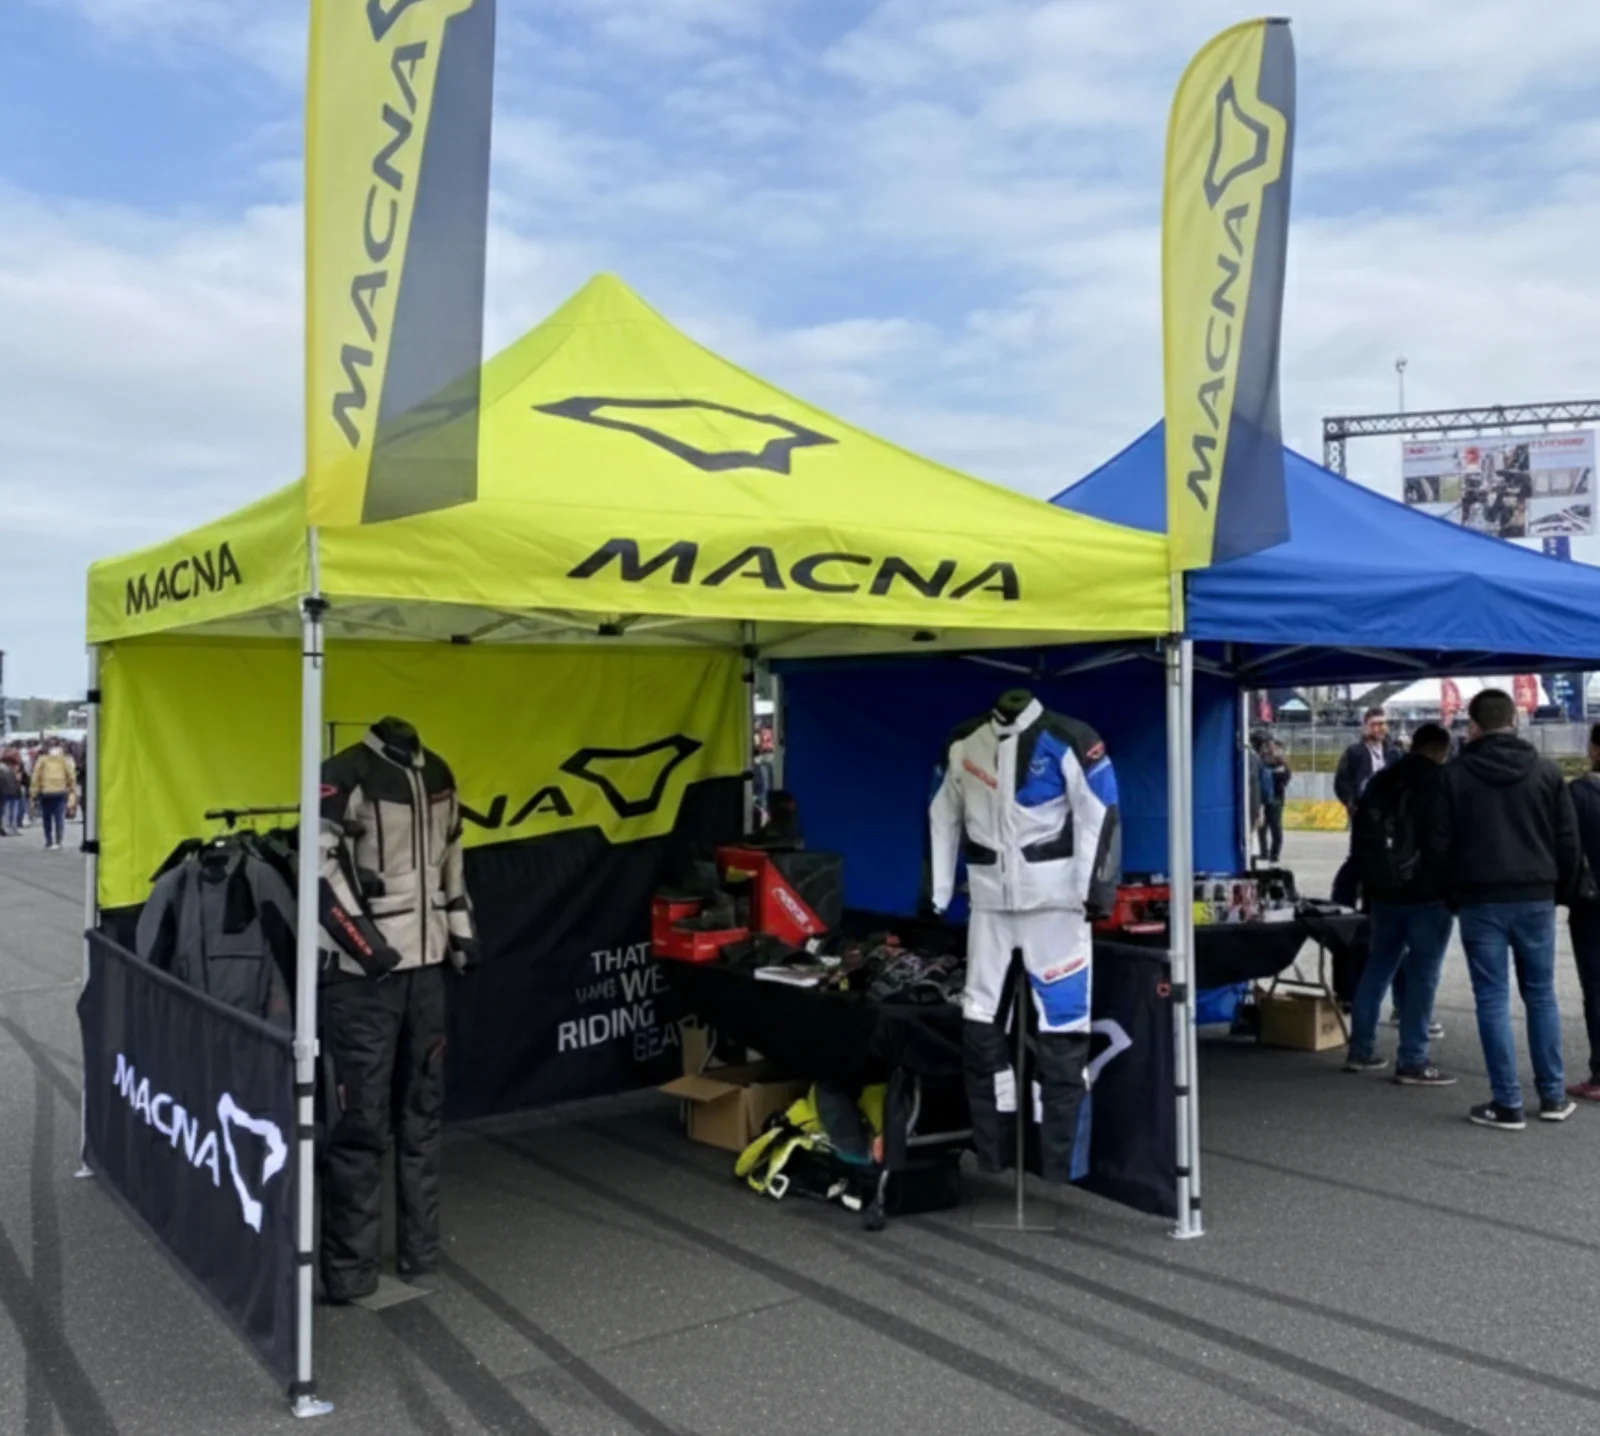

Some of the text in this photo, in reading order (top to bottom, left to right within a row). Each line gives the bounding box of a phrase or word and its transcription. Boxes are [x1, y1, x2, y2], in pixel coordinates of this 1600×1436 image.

[332, 40, 428, 450] MACNA
[1186, 202, 1249, 512] MACNA
[126, 541, 242, 616] MACNA
[566, 537, 1020, 601] MACNA
[591, 942, 650, 974] THAT
[620, 964, 671, 1002] WE
[558, 1000, 654, 1052] RIDING
[112, 1053, 220, 1187] MACNA
